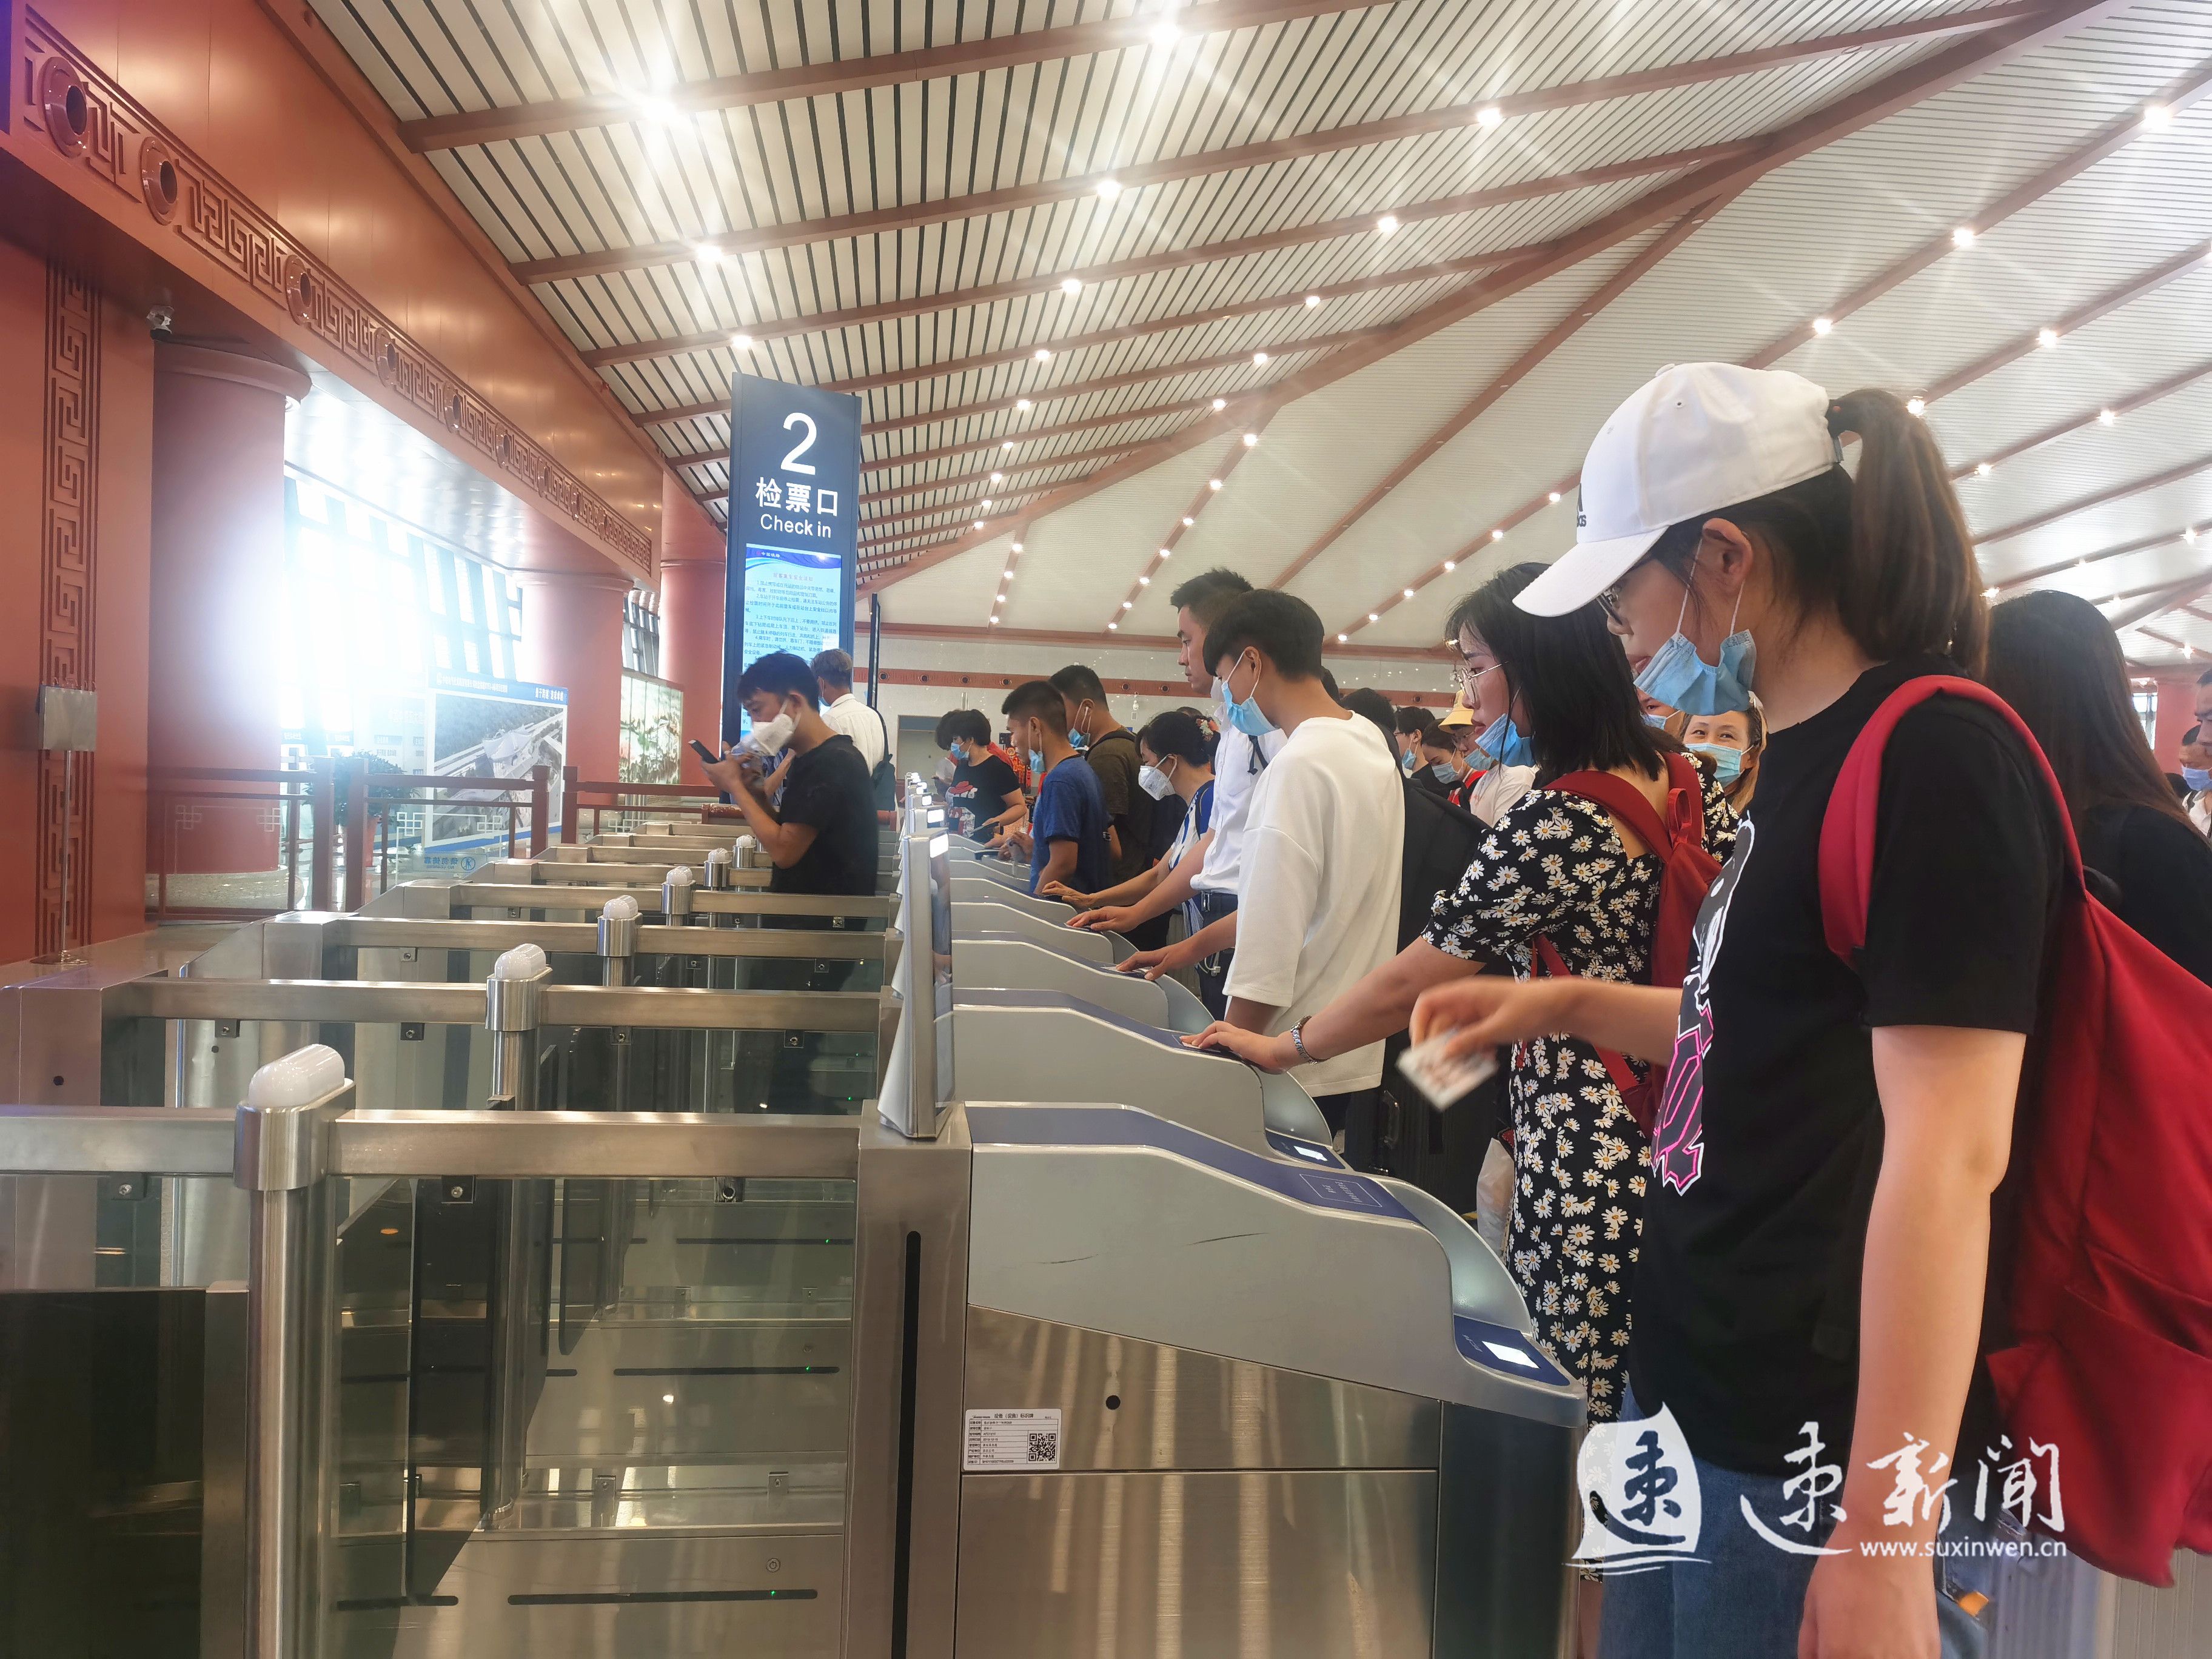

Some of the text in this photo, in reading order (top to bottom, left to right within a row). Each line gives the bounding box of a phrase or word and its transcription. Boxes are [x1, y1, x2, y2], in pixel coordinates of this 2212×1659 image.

[780, 412, 817, 475] 2
[756, 477, 837, 517] 检票口
[760, 514, 831, 538] Check in
